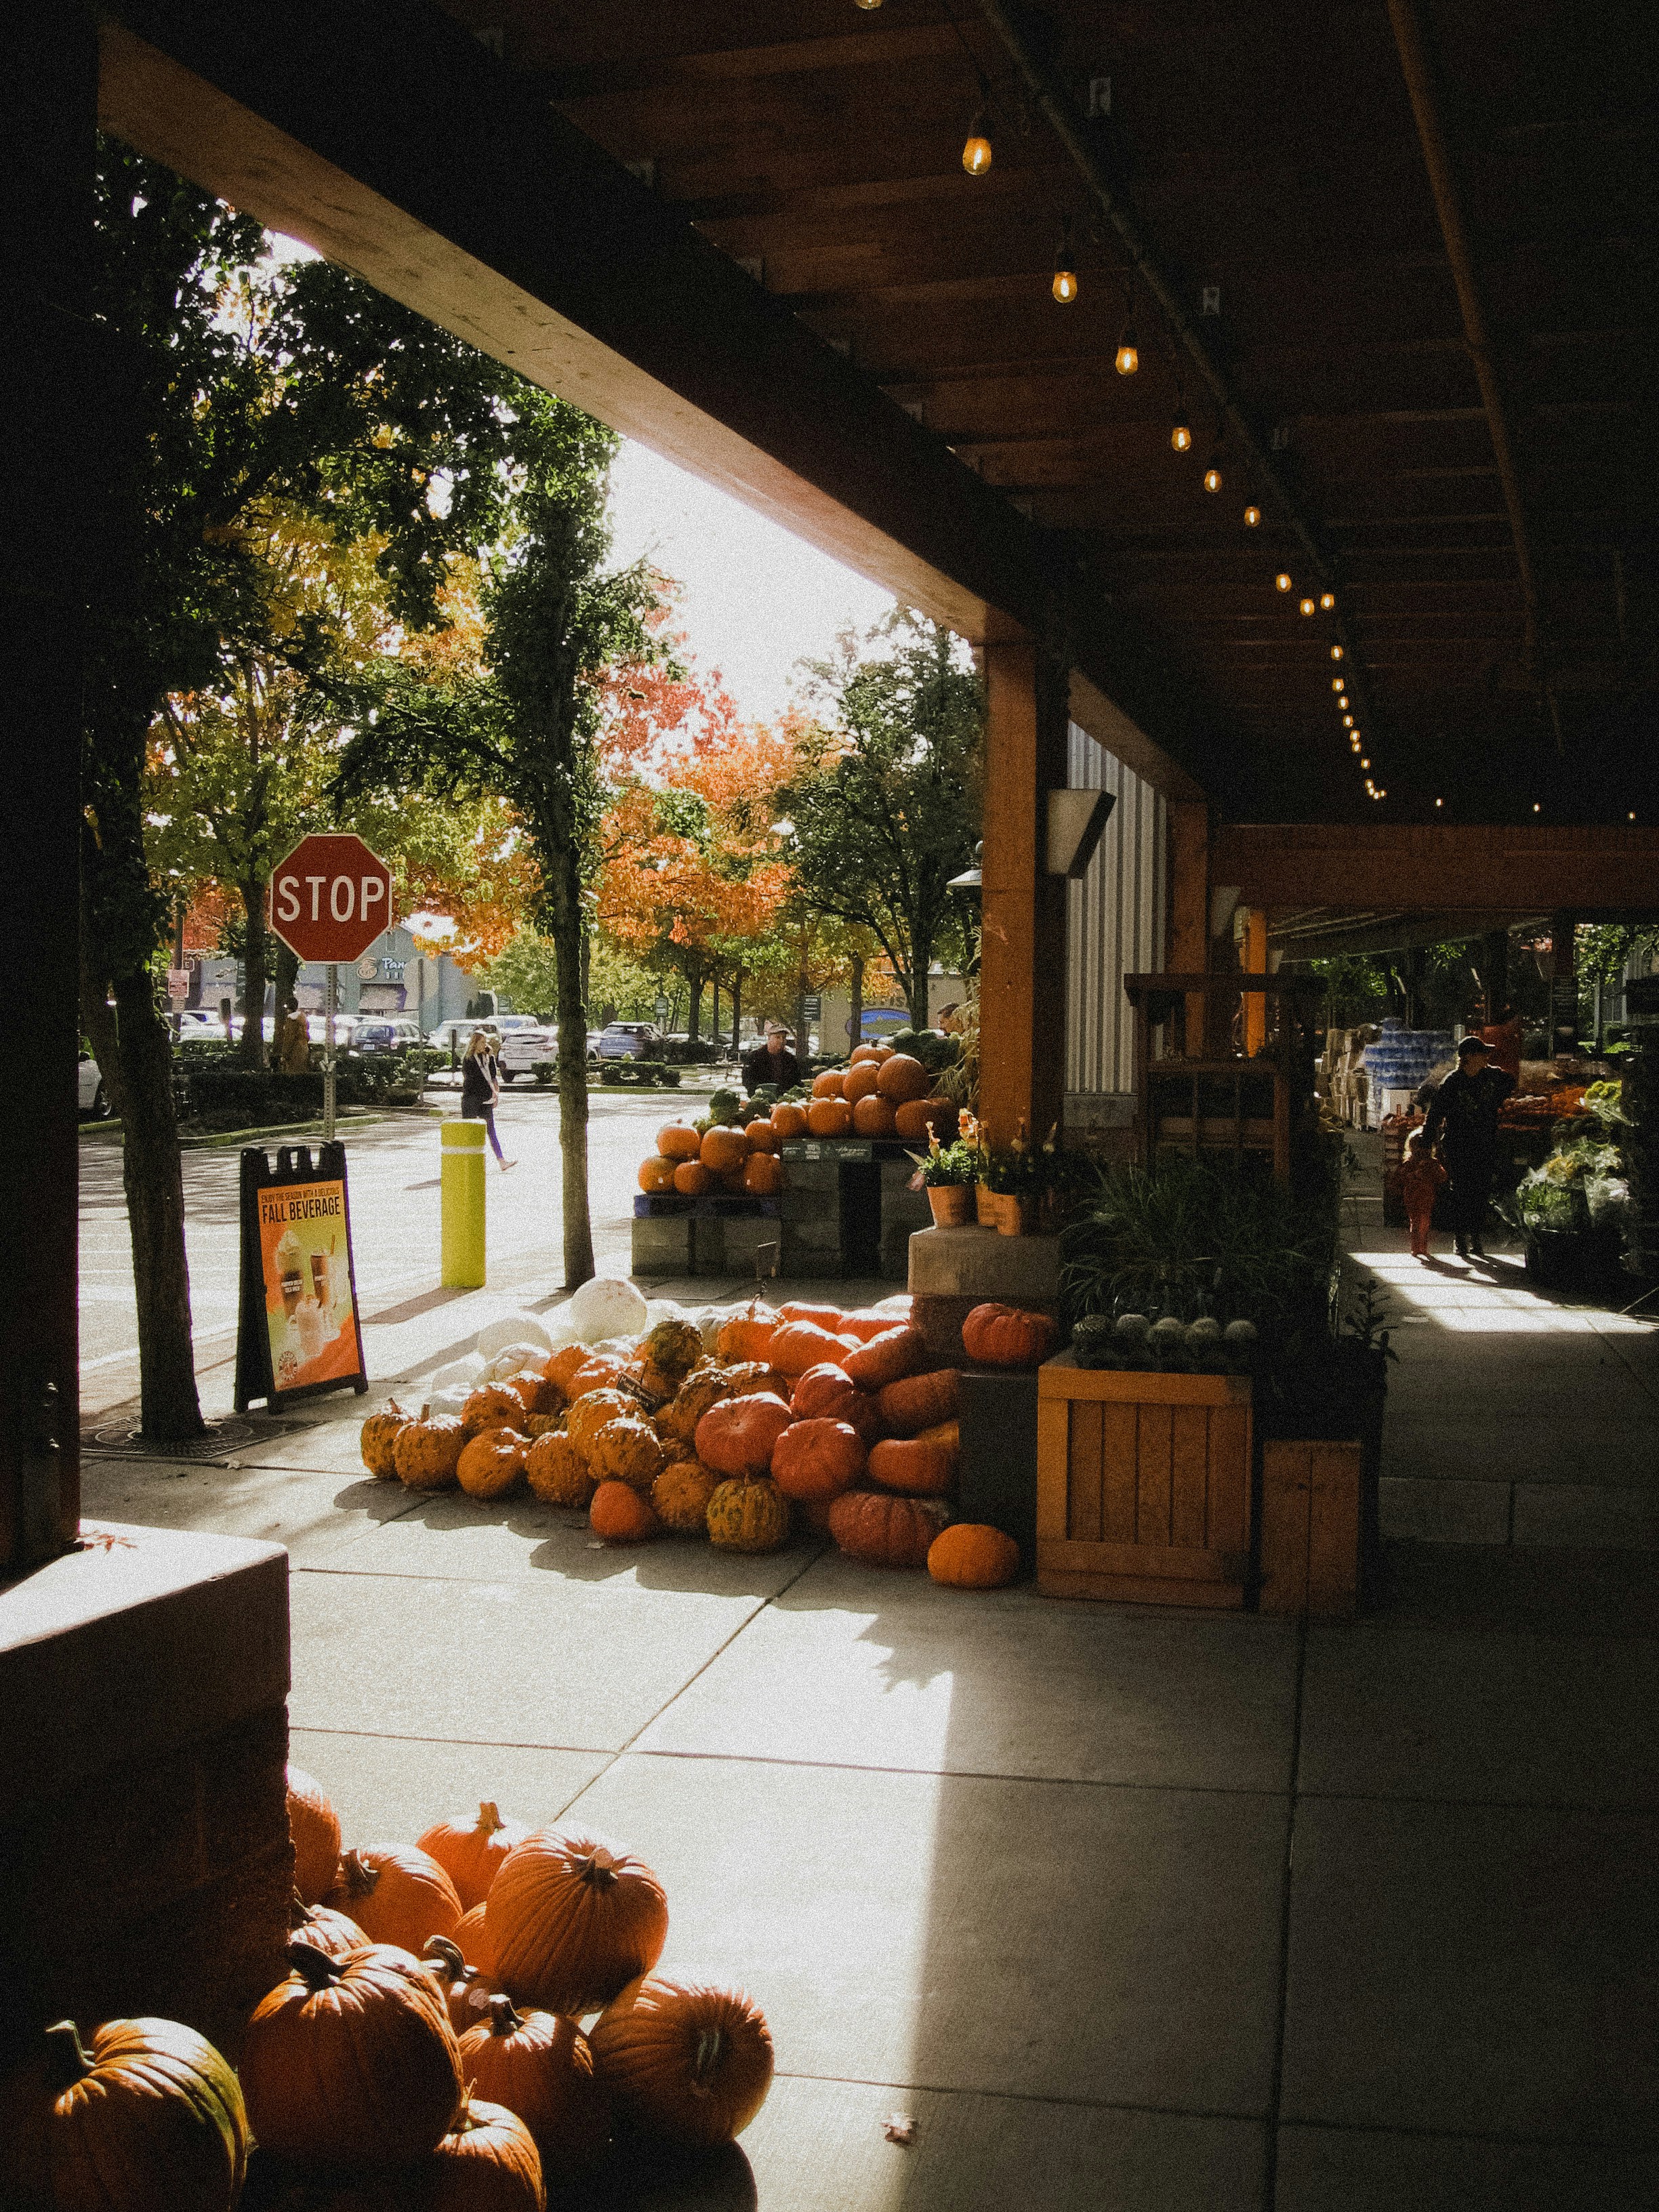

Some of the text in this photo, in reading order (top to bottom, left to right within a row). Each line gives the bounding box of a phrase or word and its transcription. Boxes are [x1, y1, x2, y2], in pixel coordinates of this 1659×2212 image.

[277, 875, 386, 922] STOP
[382, 957, 407, 970] Pan
[262, 1194, 274, 1203] ENJOY
[285, 1191, 302, 1200] SEASON
[303, 1189, 313, 1198] WITH
[319, 1187, 340, 1197] DELICIOUS
[262, 1197, 340, 1223] FALL BEVERAGE
